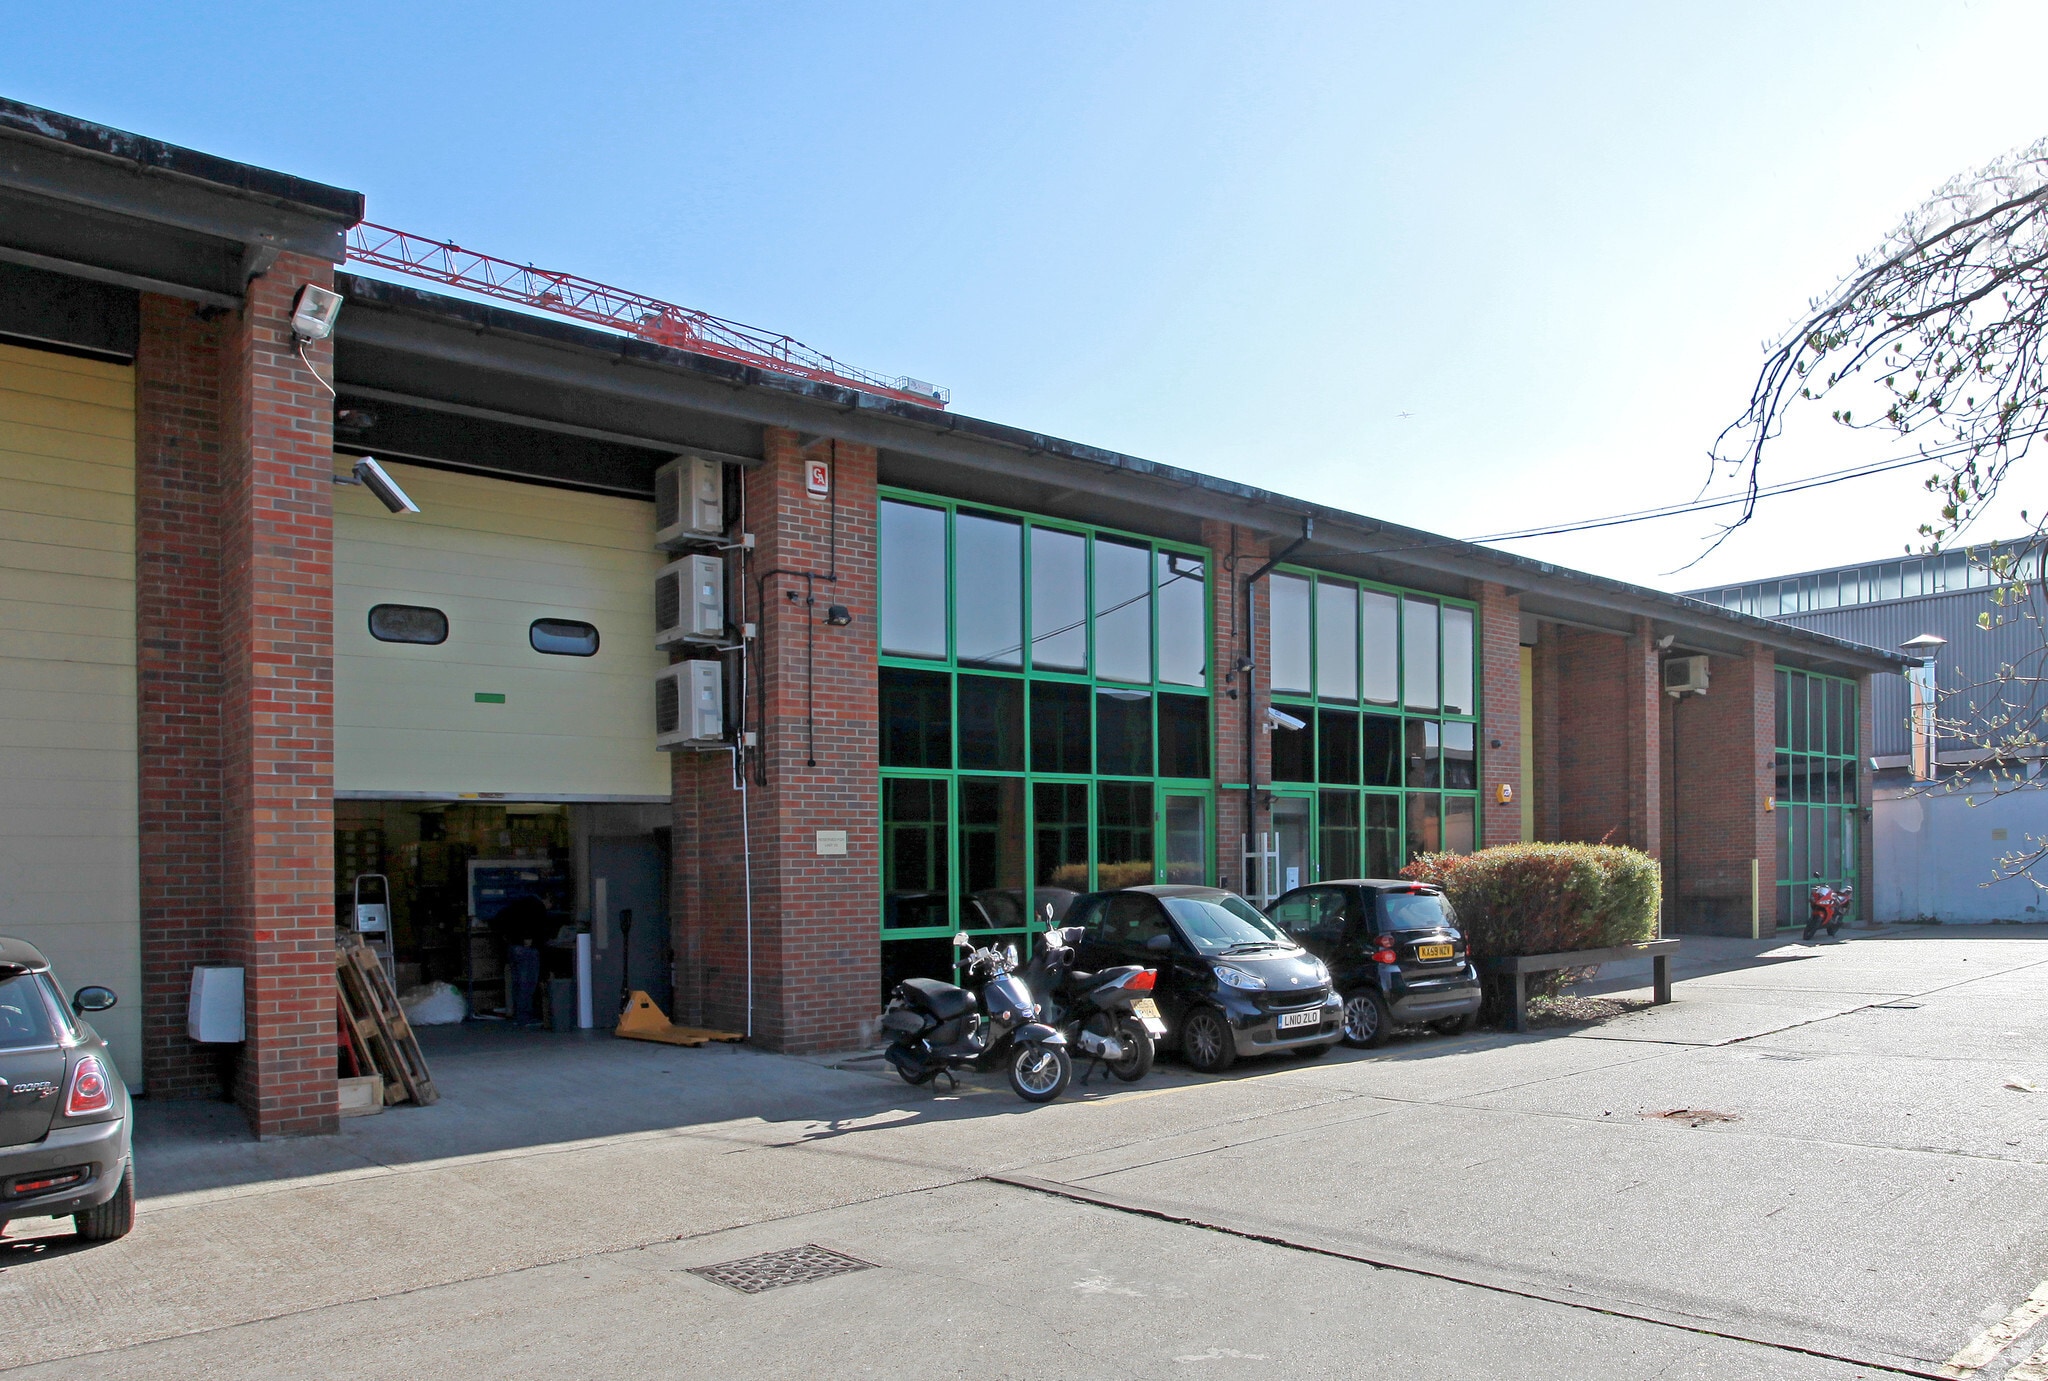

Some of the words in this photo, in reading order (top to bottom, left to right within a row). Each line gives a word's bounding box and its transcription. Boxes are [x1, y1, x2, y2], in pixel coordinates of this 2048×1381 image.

[1284, 1014, 1302, 1026] LN10
[1303, 1012, 1317, 1024] ZLO
[12, 1081, 51, 1093] COOPER
